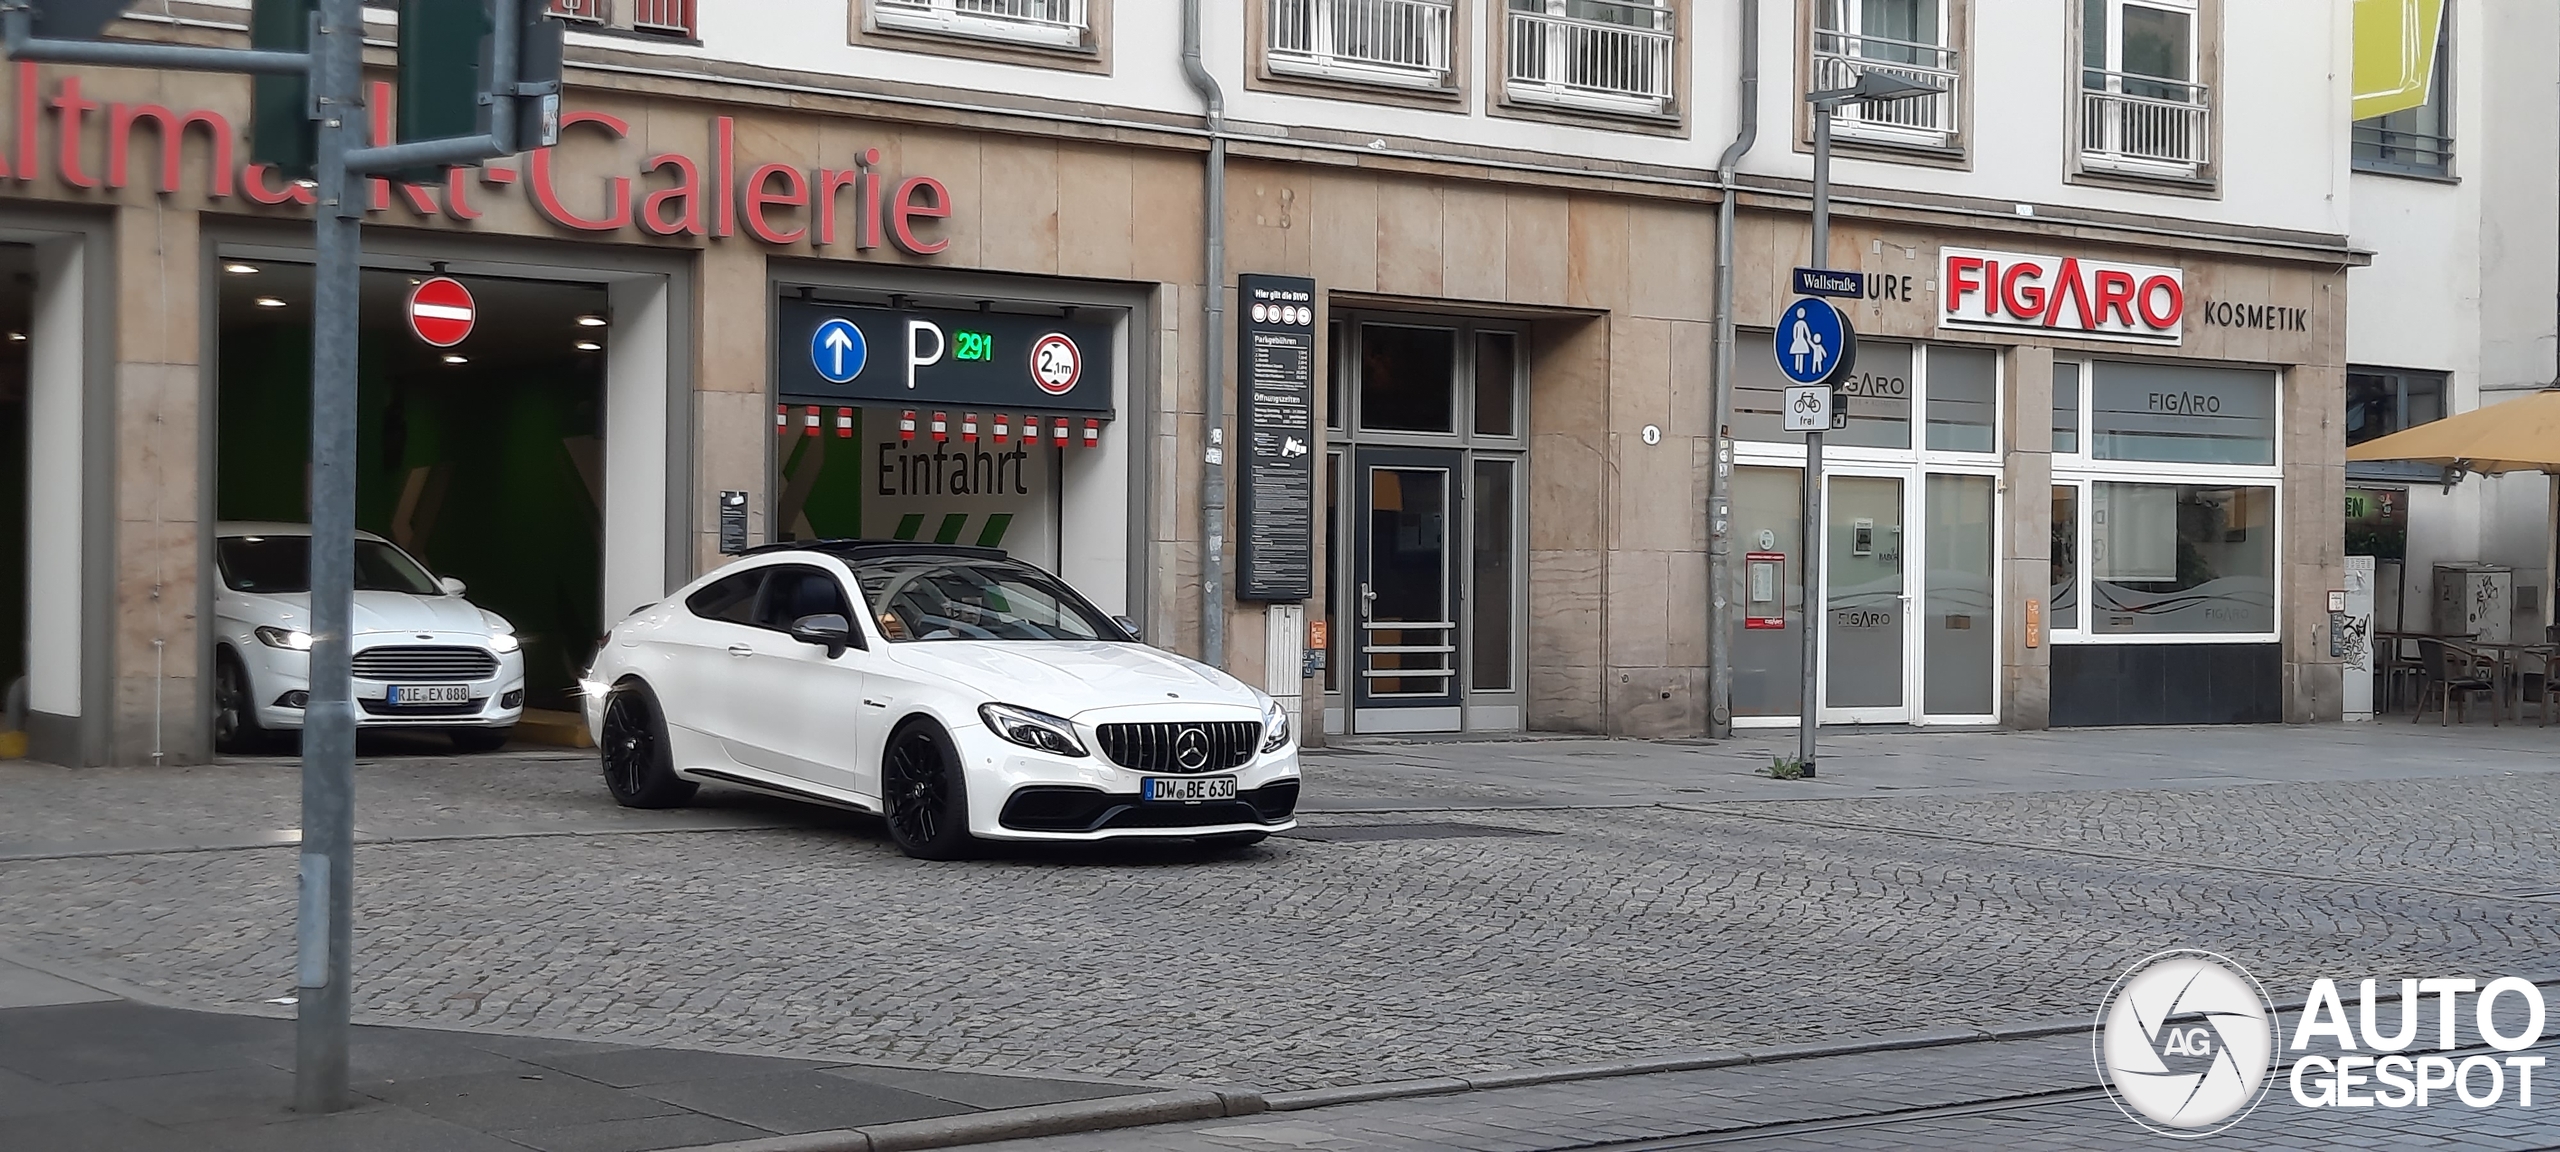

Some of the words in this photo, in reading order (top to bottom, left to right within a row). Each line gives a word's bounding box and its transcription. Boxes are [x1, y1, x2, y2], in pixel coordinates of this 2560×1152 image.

[1803, 273, 1856, 292] Wallstraße
[1255, 289, 1269, 298] Hier
[1282, 291, 1292, 300] die
[1946, 257, 2184, 330] FIGARO
[2204, 301, 2308, 332] KOSMETIK
[957, 332, 993, 361] 291
[1255, 335, 1297, 345] Parkgebühren
[907, 320, 945, 389] P
[1254, 393, 1301, 404] Öffnungszeiten
[2149, 391, 2220, 415] FIGARO
[878, 439, 1029, 496] Einfahrt
[2205, 607, 2249, 620] FIGARO
[399, 688, 421, 702] RIE
[429, 688, 444, 701] EX
[446, 687, 467, 701] 888
[1155, 781, 1176, 798] DW
[1187, 781, 1205, 798] BE
[1209, 780, 1234, 797] 630
